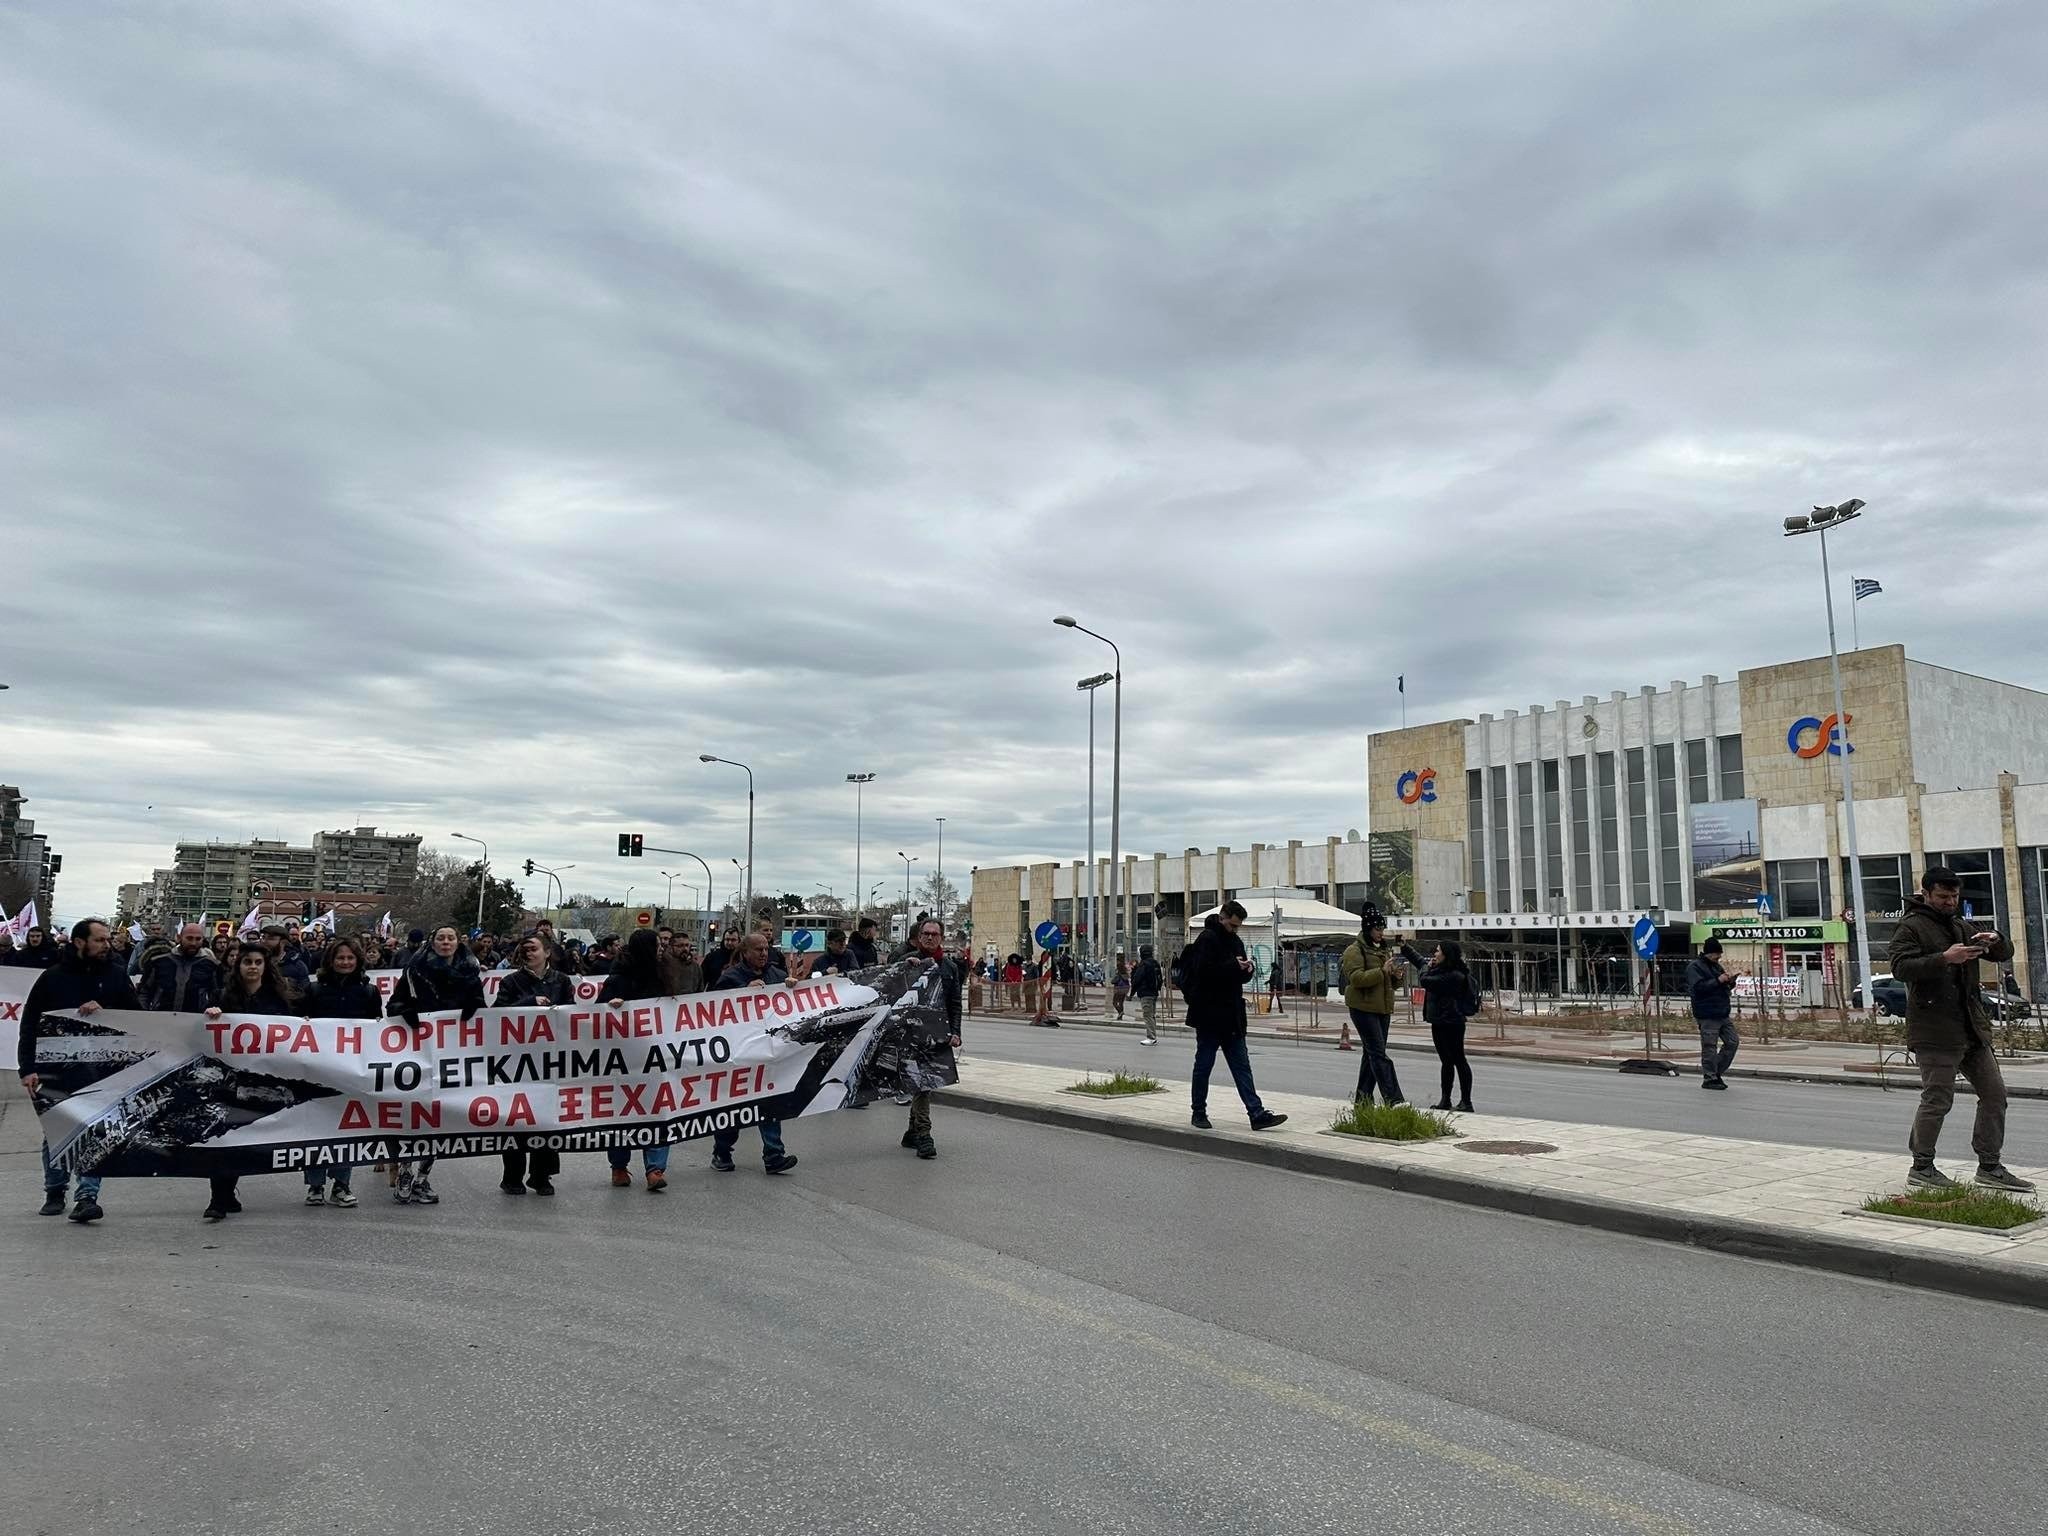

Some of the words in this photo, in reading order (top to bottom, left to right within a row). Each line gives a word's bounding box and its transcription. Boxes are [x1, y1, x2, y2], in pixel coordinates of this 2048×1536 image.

[1396, 917, 1517, 927] ΕΠΙΒΑΤΙΚΟΣ
[1532, 914, 1635, 926] ΣΤΑΘΜΟΣ
[1726, 928, 1807, 938] ΦΑΡΜΑΚΕΙΟ
[206, 1022, 320, 1055] ΤΩΡΑ
[336, 1026, 362, 1054] Η
[380, 1017, 483, 1053] ΟΡΓΗ
[501, 1014, 555, 1045] ΝΑ
[570, 1007, 664, 1041] ΓΙΝΕΙ
[675, 983, 839, 1032] ΑΝΑΤΡΟΠΗ
[368, 1061, 422, 1092] ΤΟ
[439, 1048, 628, 1089] ΕΓΚΛΗΜΑ
[642, 1035, 731, 1074] ΑΥΤΟ
[338, 1100, 441, 1130] ΔΕΝ
[468, 1093, 537, 1127] ΘΑ
[558, 1064, 775, 1123] ΞΕΧΑΣΤΕΙ.
[272, 1140, 390, 1169] ΕΡΓΑΤΙΚΑ
[398, 1135, 519, 1158] ΣΩΜΑΤΕΙΑ
[527, 1128, 660, 1151] ΦΟΙΤΗΤΙΚΟΙ
[667, 1104, 765, 1141] ΣΥΛΛΟΓΟΙ.
